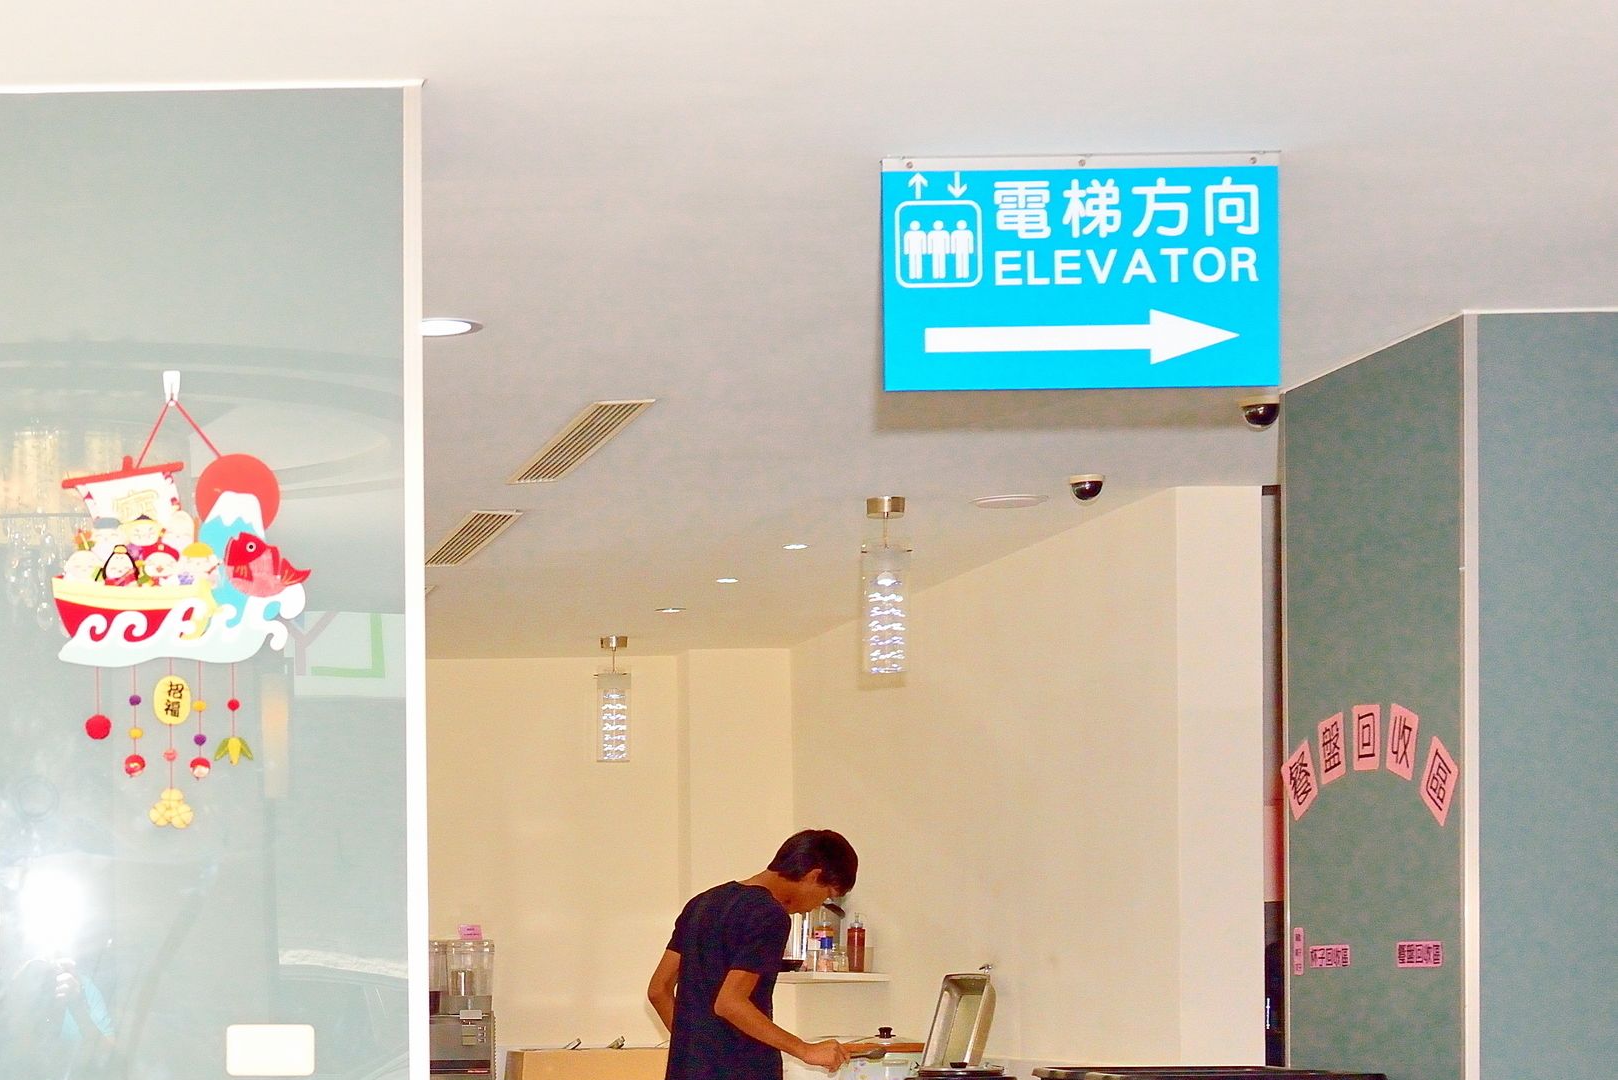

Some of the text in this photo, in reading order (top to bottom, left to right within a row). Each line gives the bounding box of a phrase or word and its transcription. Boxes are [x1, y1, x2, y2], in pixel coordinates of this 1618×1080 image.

[993, 176, 1260, 239] 電梯方向
[994, 246, 1259, 286] ELEVATOR
[164, 681, 184, 718] 招福
[1288, 711, 1452, 812] 餐盤回收區
